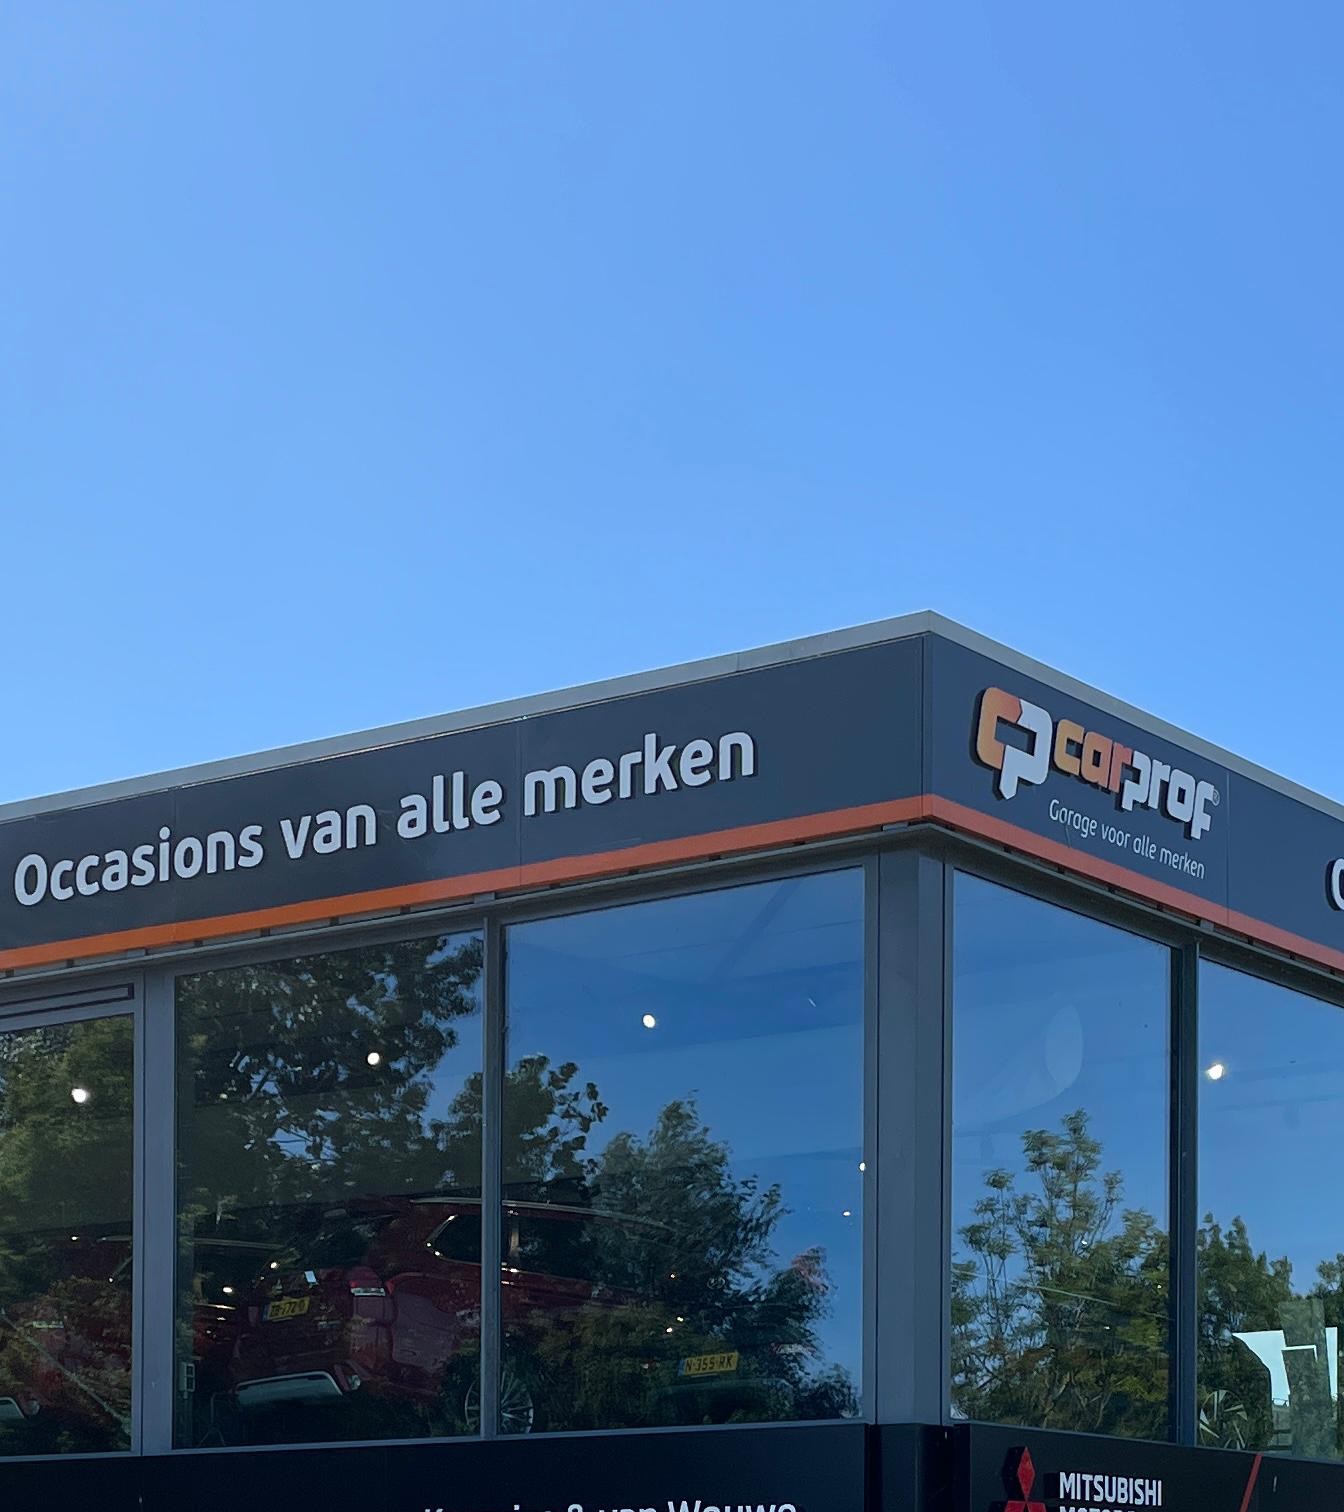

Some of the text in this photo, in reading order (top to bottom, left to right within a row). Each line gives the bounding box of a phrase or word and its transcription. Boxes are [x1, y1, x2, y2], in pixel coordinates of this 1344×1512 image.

[14, 731, 757, 907] Occasions van alle merken
[1049, 799, 1206, 880] Garage voor alle merken
[1059, 1471, 1163, 1507] MITSUBISHI
